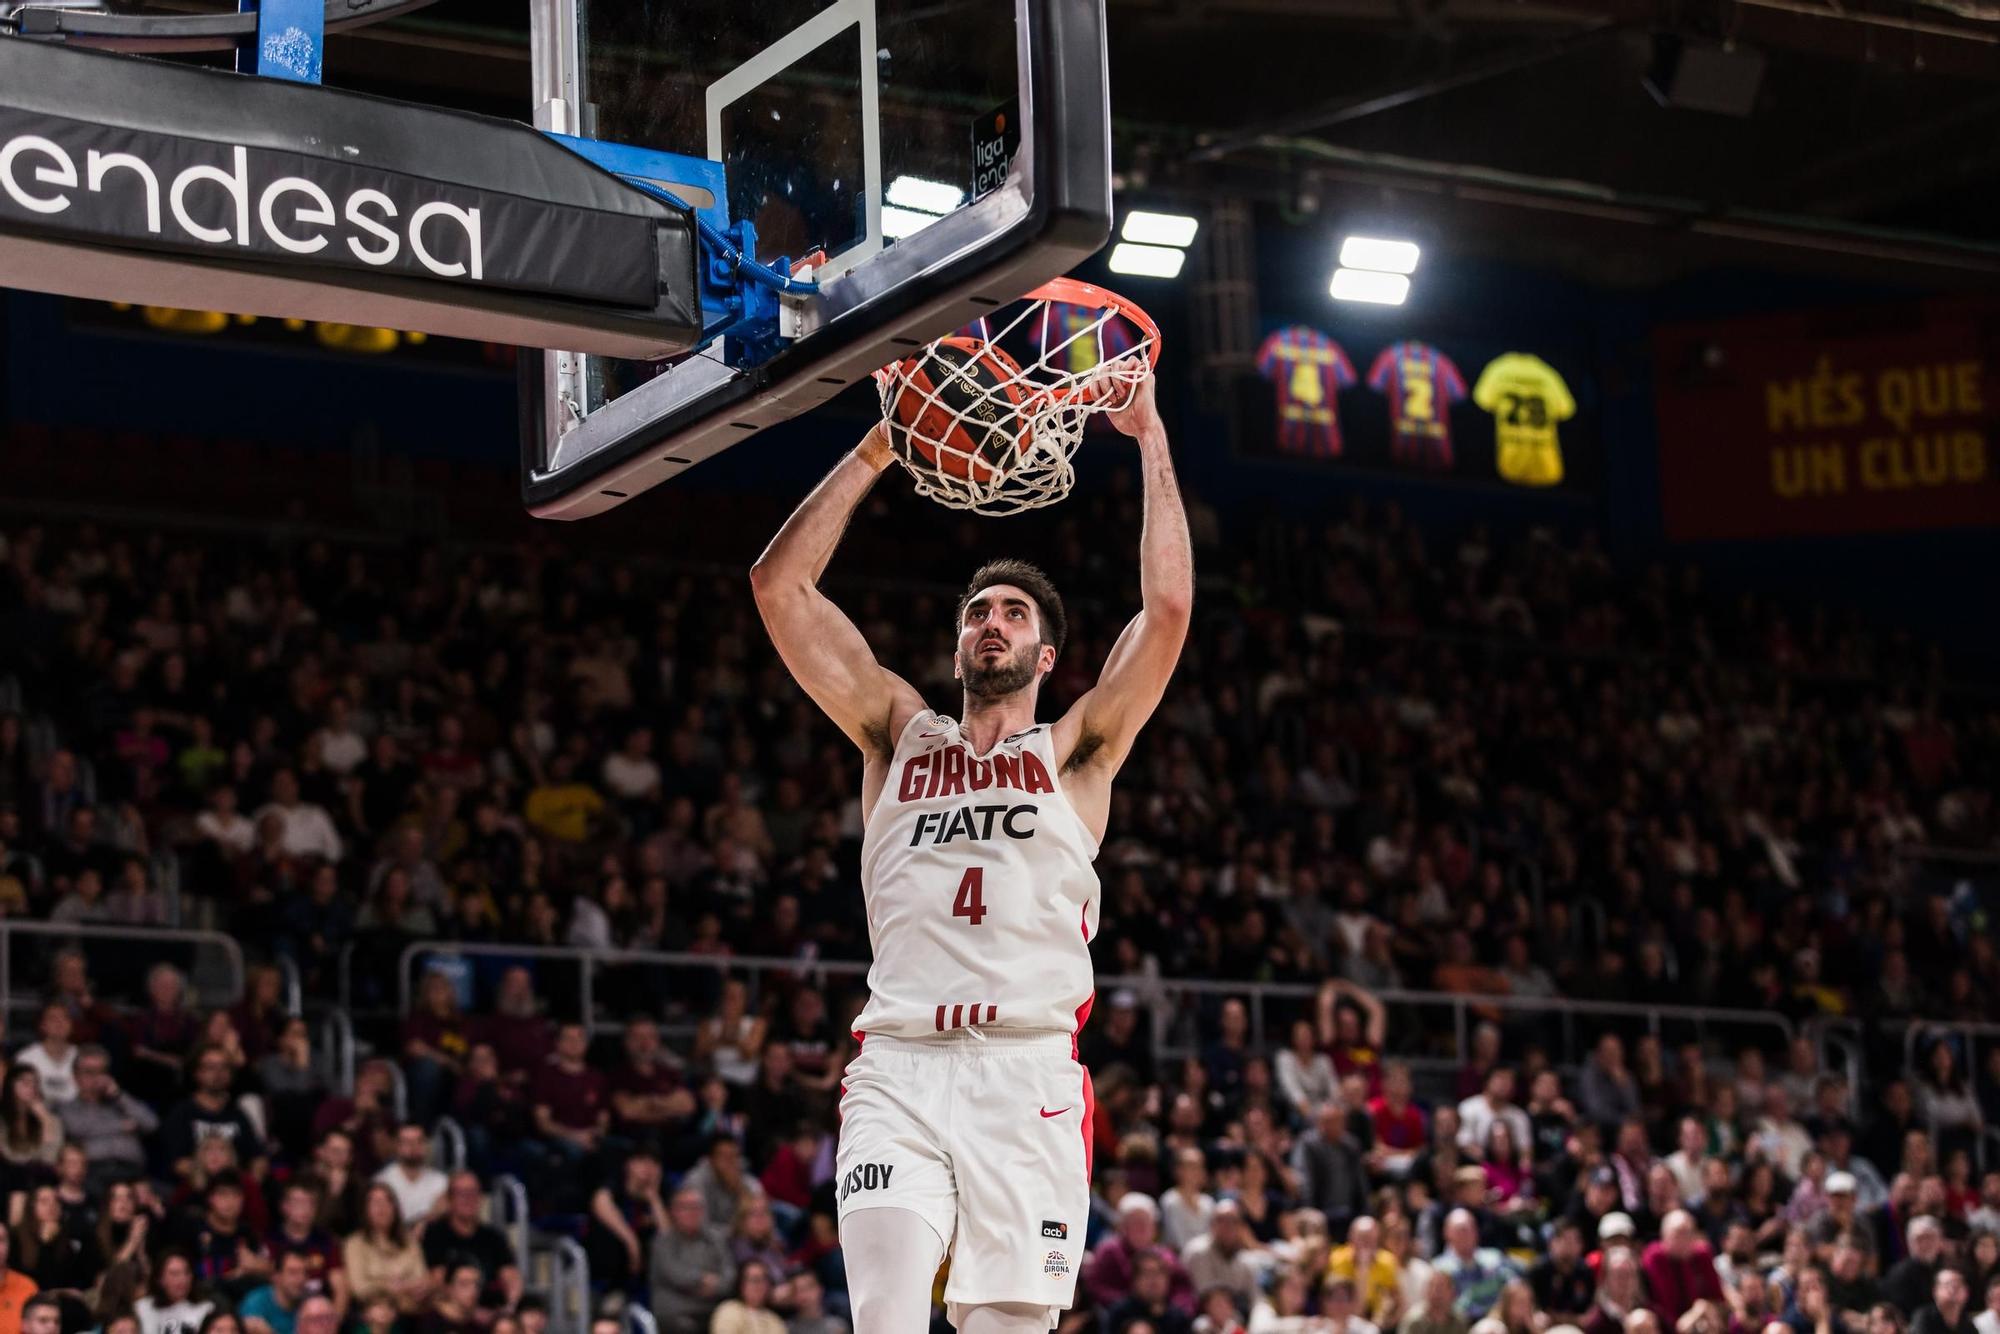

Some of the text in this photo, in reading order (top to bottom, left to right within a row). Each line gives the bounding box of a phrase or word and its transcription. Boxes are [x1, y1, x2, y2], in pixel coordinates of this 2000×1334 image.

[976, 135, 1004, 167] liga
[0, 134, 483, 280] endesa
[1766, 354, 1984, 432] MÉS QUE
[1771, 430, 1986, 498] UN CLUB
[898, 744, 1055, 803] GIRONA
[909, 804, 1038, 847] FIATC
[952, 867, 987, 926] 4
[1043, 1227, 1063, 1238] acb
[1044, 1265, 1070, 1273] GIRONA
